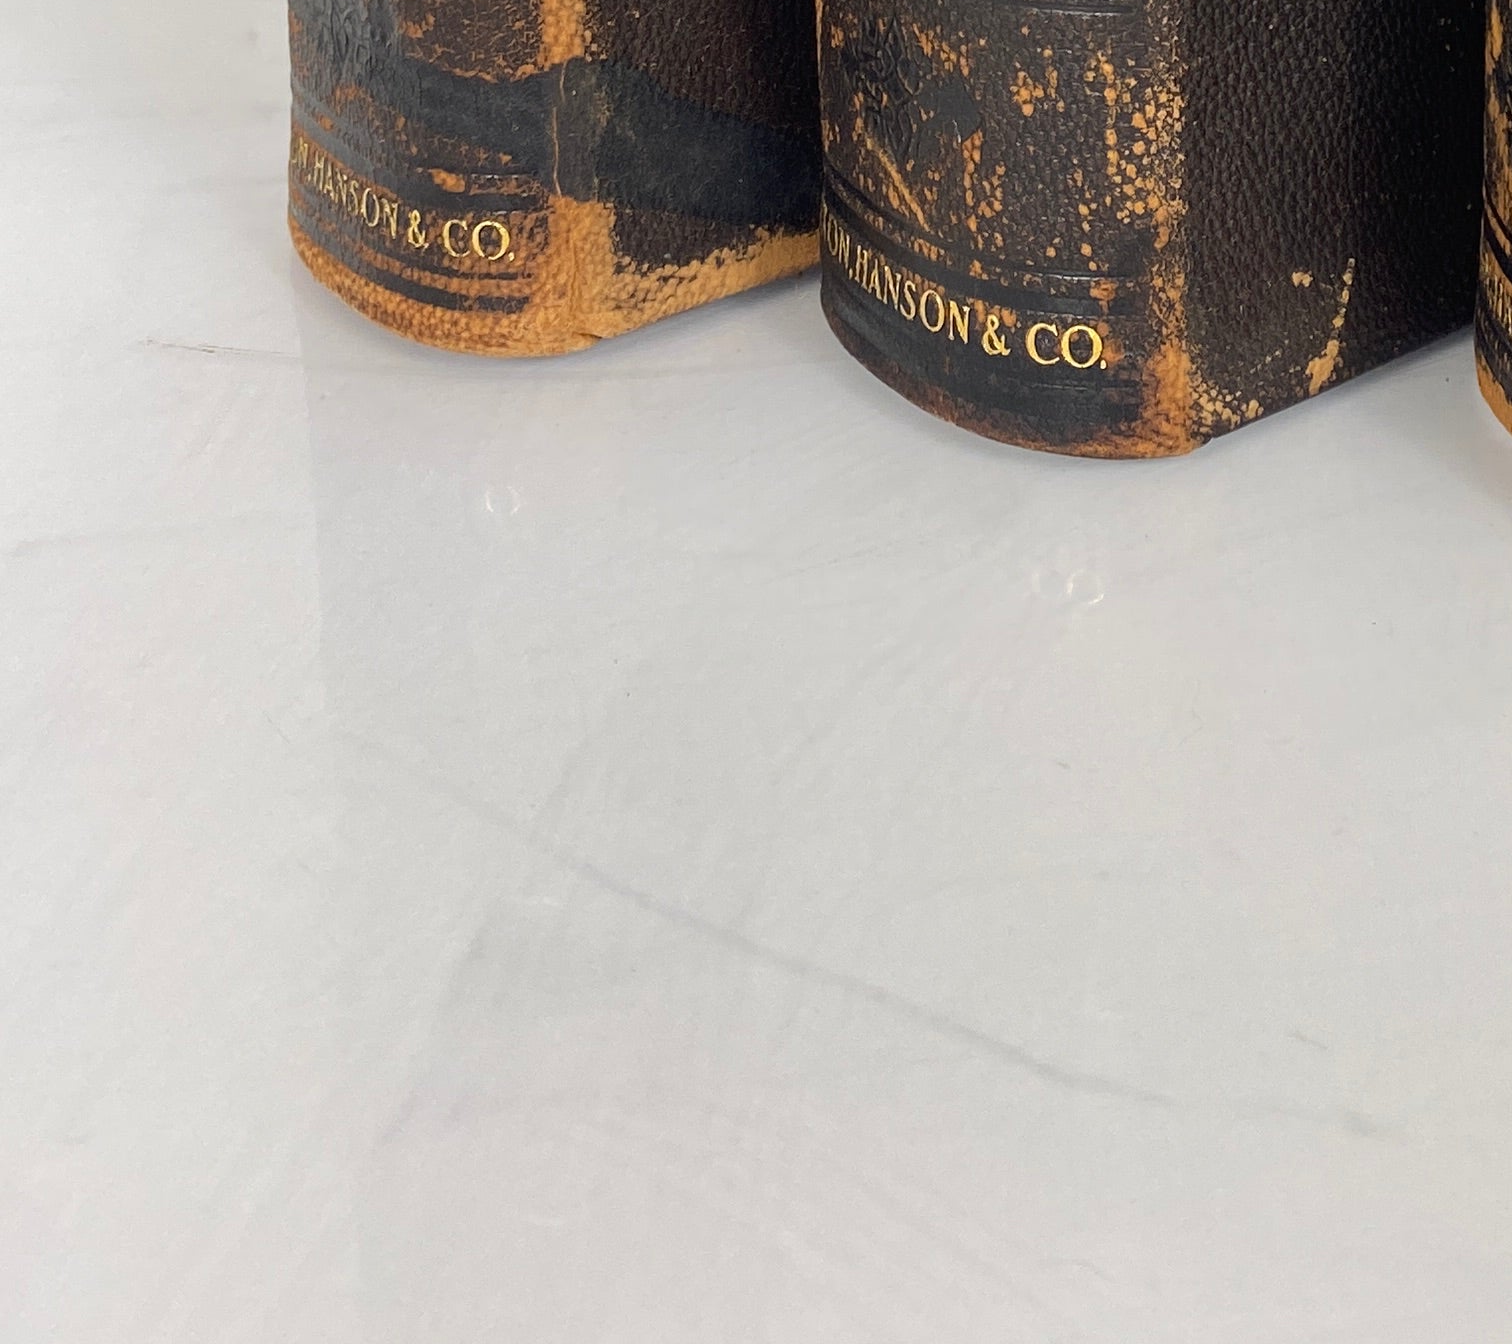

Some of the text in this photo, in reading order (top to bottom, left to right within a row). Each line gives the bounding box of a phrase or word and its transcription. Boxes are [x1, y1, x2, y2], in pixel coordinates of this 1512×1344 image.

[407, 209, 429, 249] &
[442, 219, 516, 262] CO.
[854, 244, 971, 345] HANSON
[981, 313, 1011, 357] &
[1025, 322, 1107, 370] CO.
